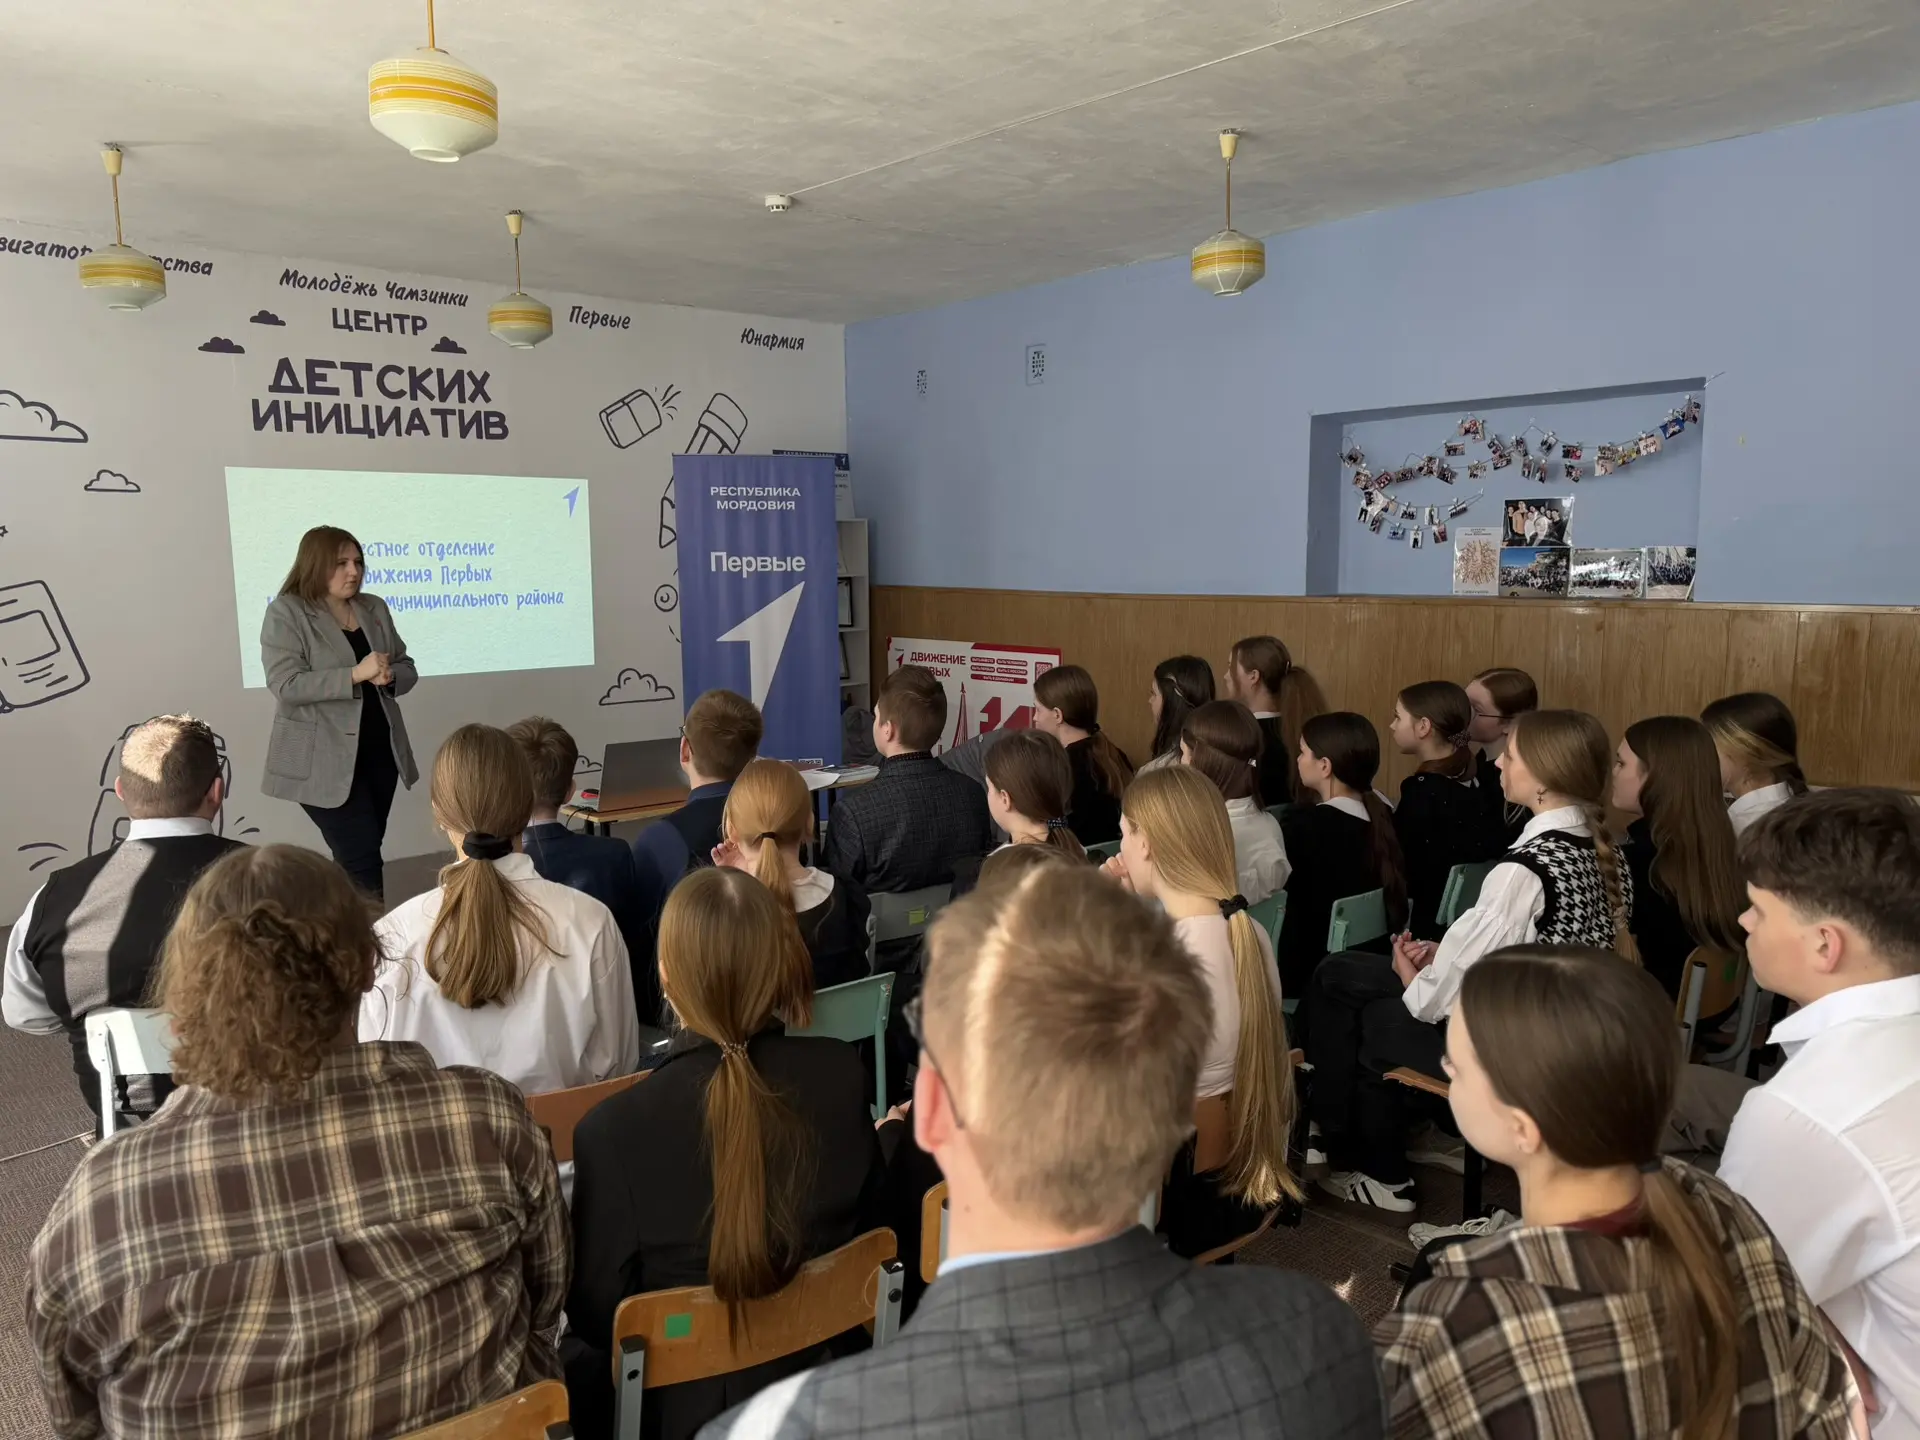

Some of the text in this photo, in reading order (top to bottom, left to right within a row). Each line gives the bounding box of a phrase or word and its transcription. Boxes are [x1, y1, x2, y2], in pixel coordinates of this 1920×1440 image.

[279, 268, 469, 307] Молодёжь Чамзинки
[331, 307, 428, 336] ЦЕНТР
[569, 305, 631, 329] Первые
[740, 327, 805, 351] Юнармия
[268, 356, 492, 404] ДЕТСКИХ
[251, 398, 509, 440] ИНИЦИАТИВ
[710, 486, 802, 497] РЕСПУБЛИКА
[716, 500, 796, 511] МОРДОВИЯ
[362, 542, 495, 561] естное отделение
[364, 564, 492, 587] вижения Первых
[710, 551, 806, 578] Первые
[385, 589, 564, 612] муниципального района
[910, 652, 966, 665] ДВИЖЕНИЕ
[930, 667, 951, 678] ВЫХ
